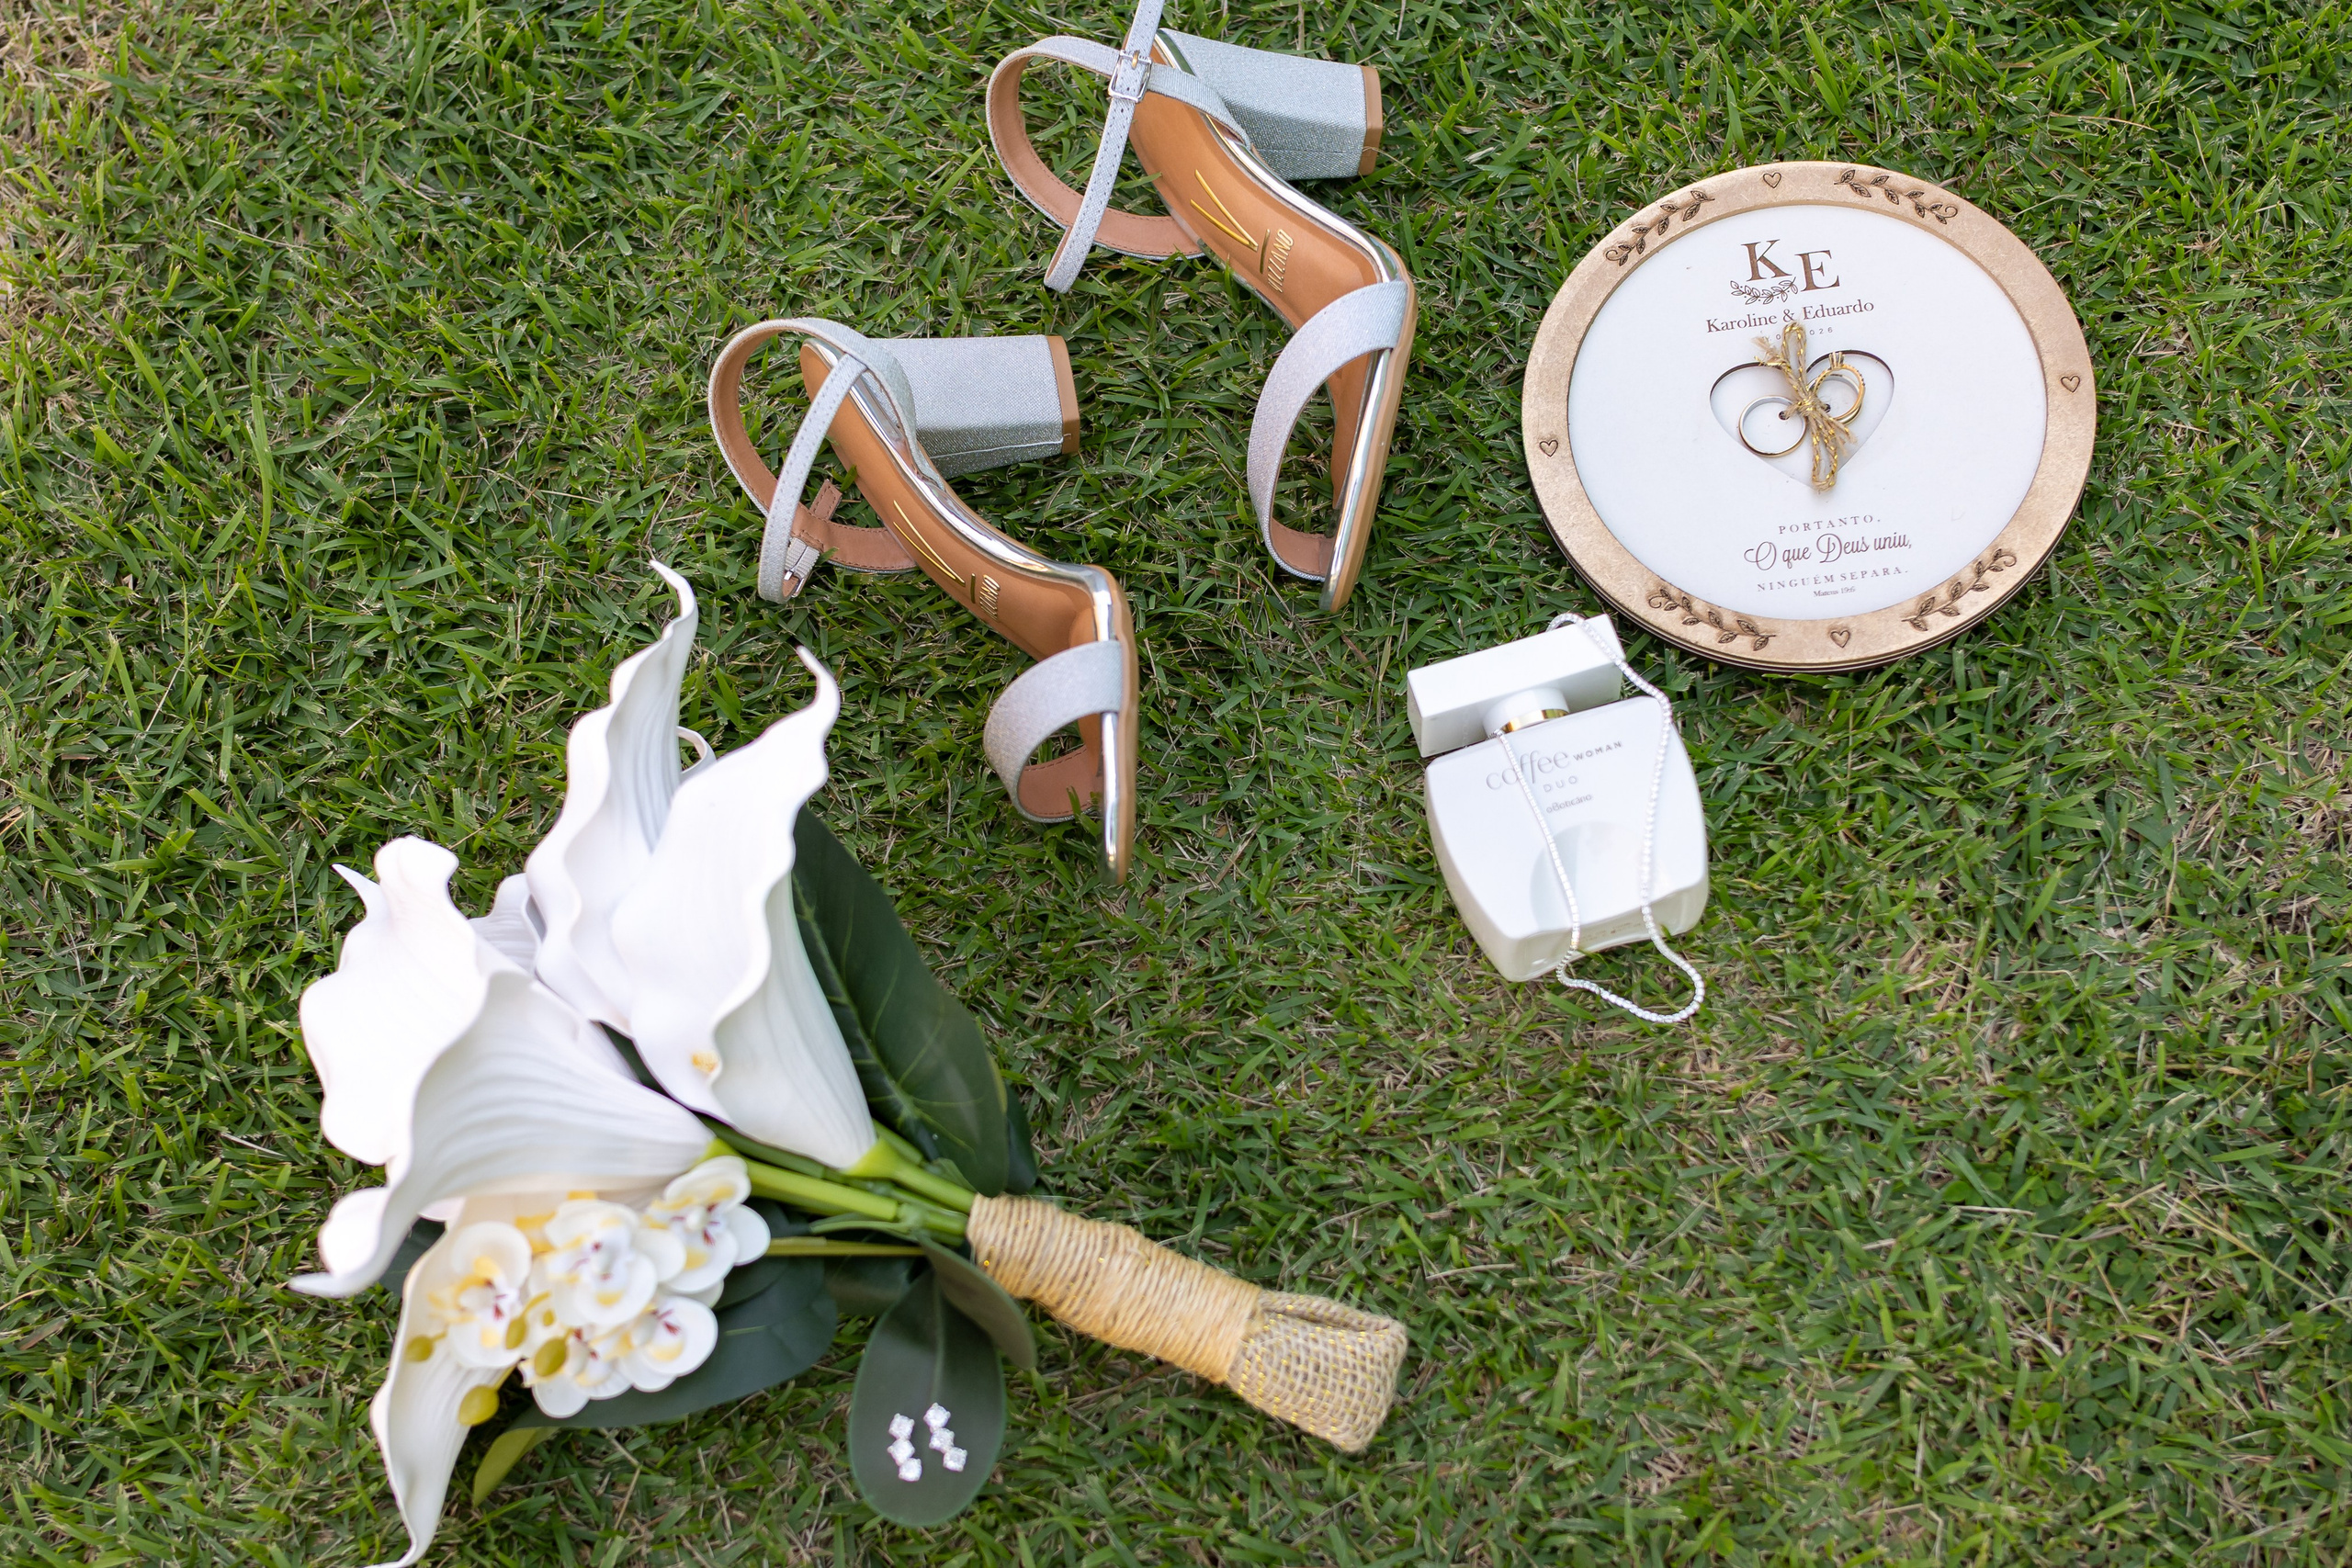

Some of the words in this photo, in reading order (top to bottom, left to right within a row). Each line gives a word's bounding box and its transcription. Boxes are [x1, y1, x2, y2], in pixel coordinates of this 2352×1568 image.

[1741, 239, 1792, 282] K
[1794, 249, 1840, 292] E
[1706, 313, 1778, 333] Karoline
[1782, 308, 1795, 322] &
[1802, 299, 1875, 321] Eduardo
[1743, 541, 1778, 571] O
[1781, 546, 1812, 569] que
[1815, 533, 1870, 564] Deus
[978, 574, 1001, 622] IZZANO
[1757, 573, 1836, 592] NINGUÉM
[1485, 750, 1568, 790] coffee
[1573, 740, 1623, 761] WOMAN
[1543, 775, 1578, 793] DUO
